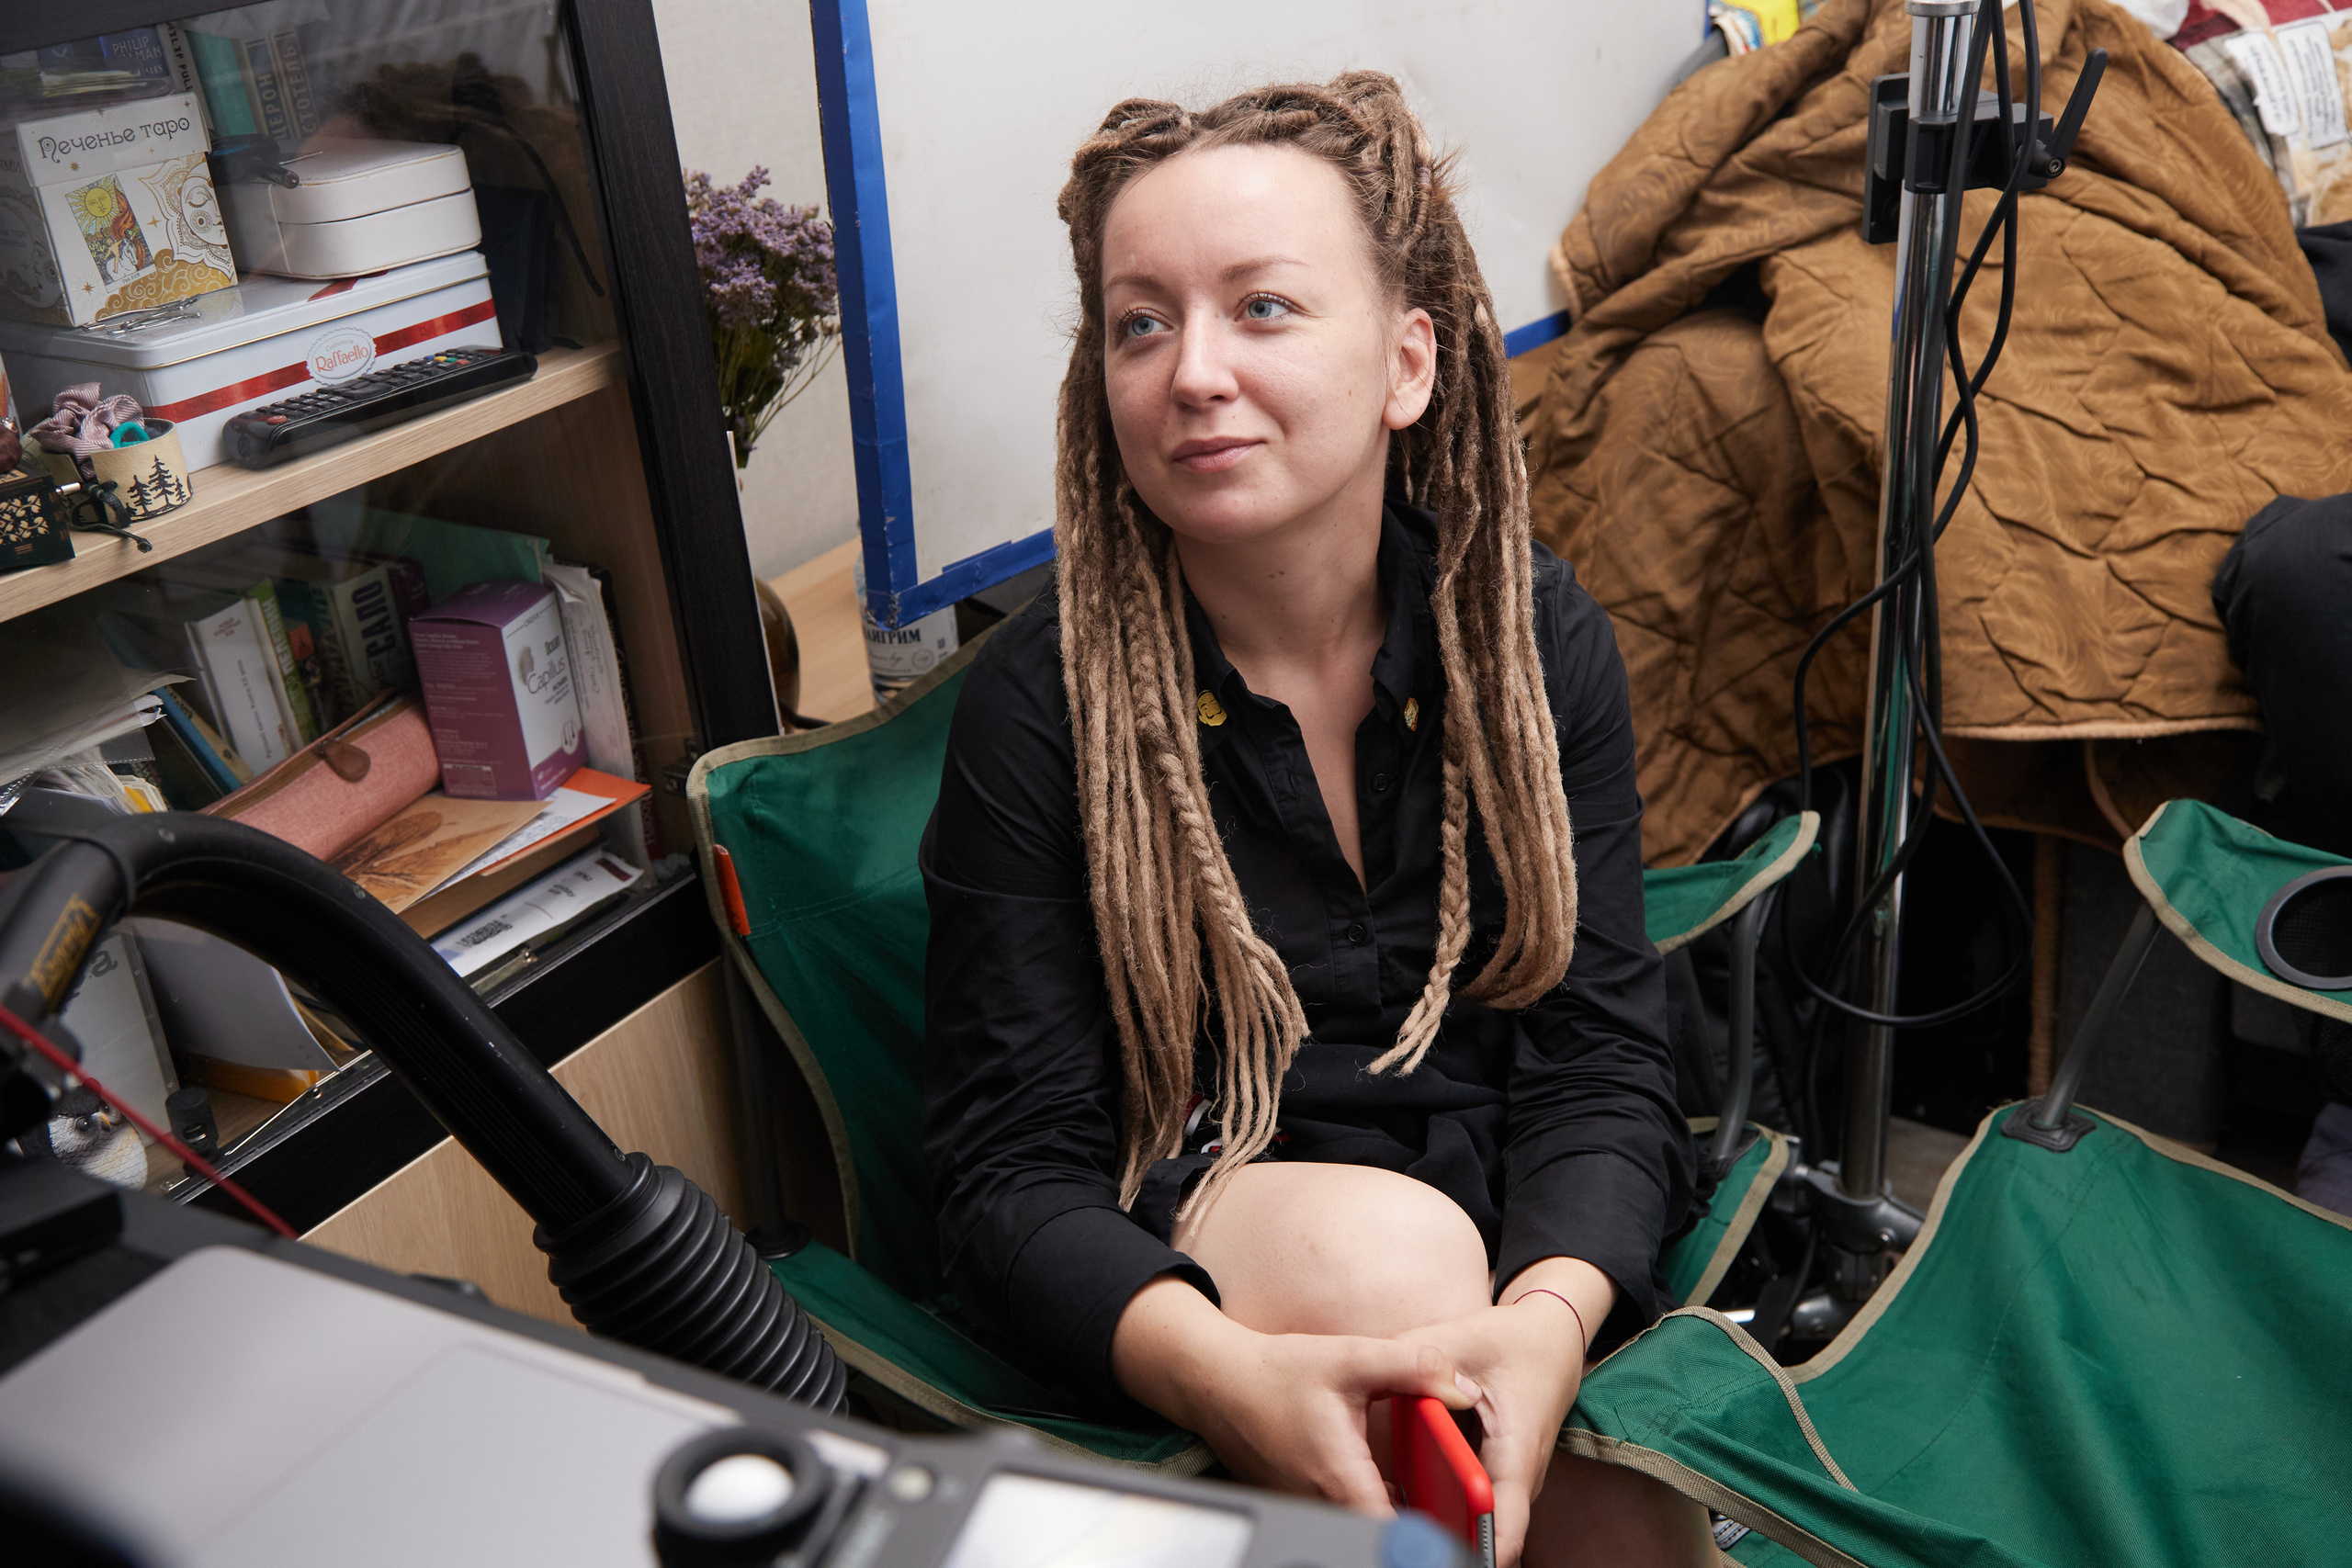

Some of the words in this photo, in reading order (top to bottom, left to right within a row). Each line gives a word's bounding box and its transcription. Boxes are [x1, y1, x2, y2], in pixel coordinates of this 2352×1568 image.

[111, 36, 149, 55] PHILIP
[38, 128, 136, 164] Печенье
[139, 118, 190, 141] таро
[315, 344, 369, 372] Raffaello
[865, 628, 922, 645] ЛИГРИМ
[527, 656, 566, 694] Capillus
